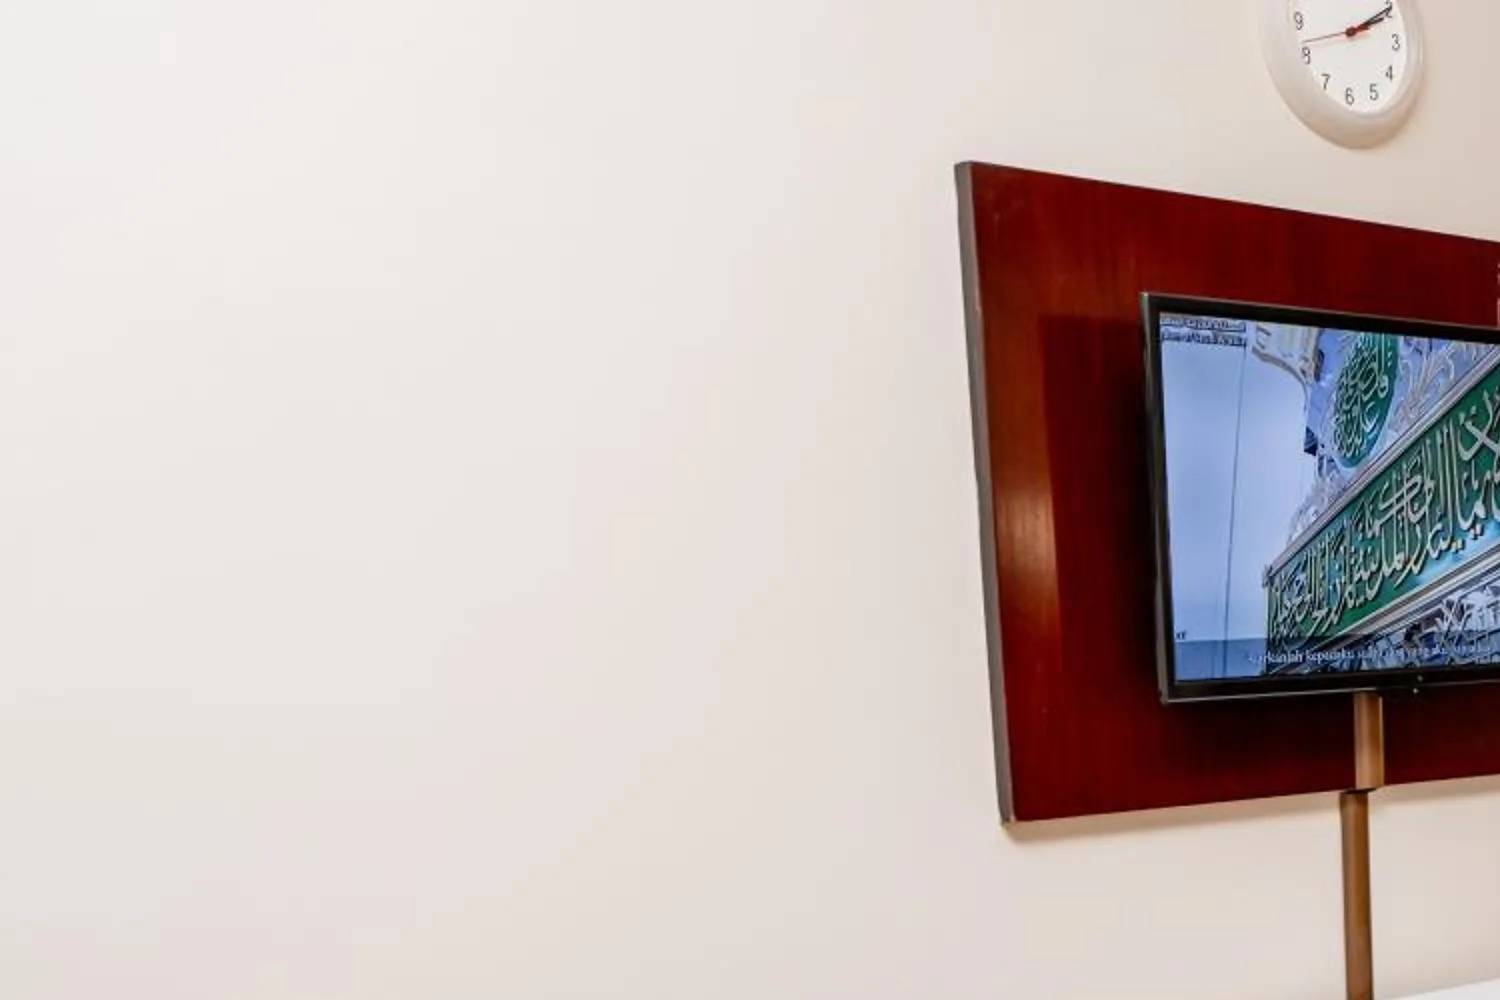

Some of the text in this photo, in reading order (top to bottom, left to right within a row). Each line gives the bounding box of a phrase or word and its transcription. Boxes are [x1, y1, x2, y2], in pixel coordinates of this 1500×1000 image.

[1293, 11, 1304, 30] 9
[1391, 33, 1400, 51] 3
[1301, 46, 1311, 65] 8
[1321, 73, 1330, 90] 7
[1385, 65, 1393, 81] 4
[1345, 87, 1354, 106] 6
[1369, 83, 1379, 101] 5
